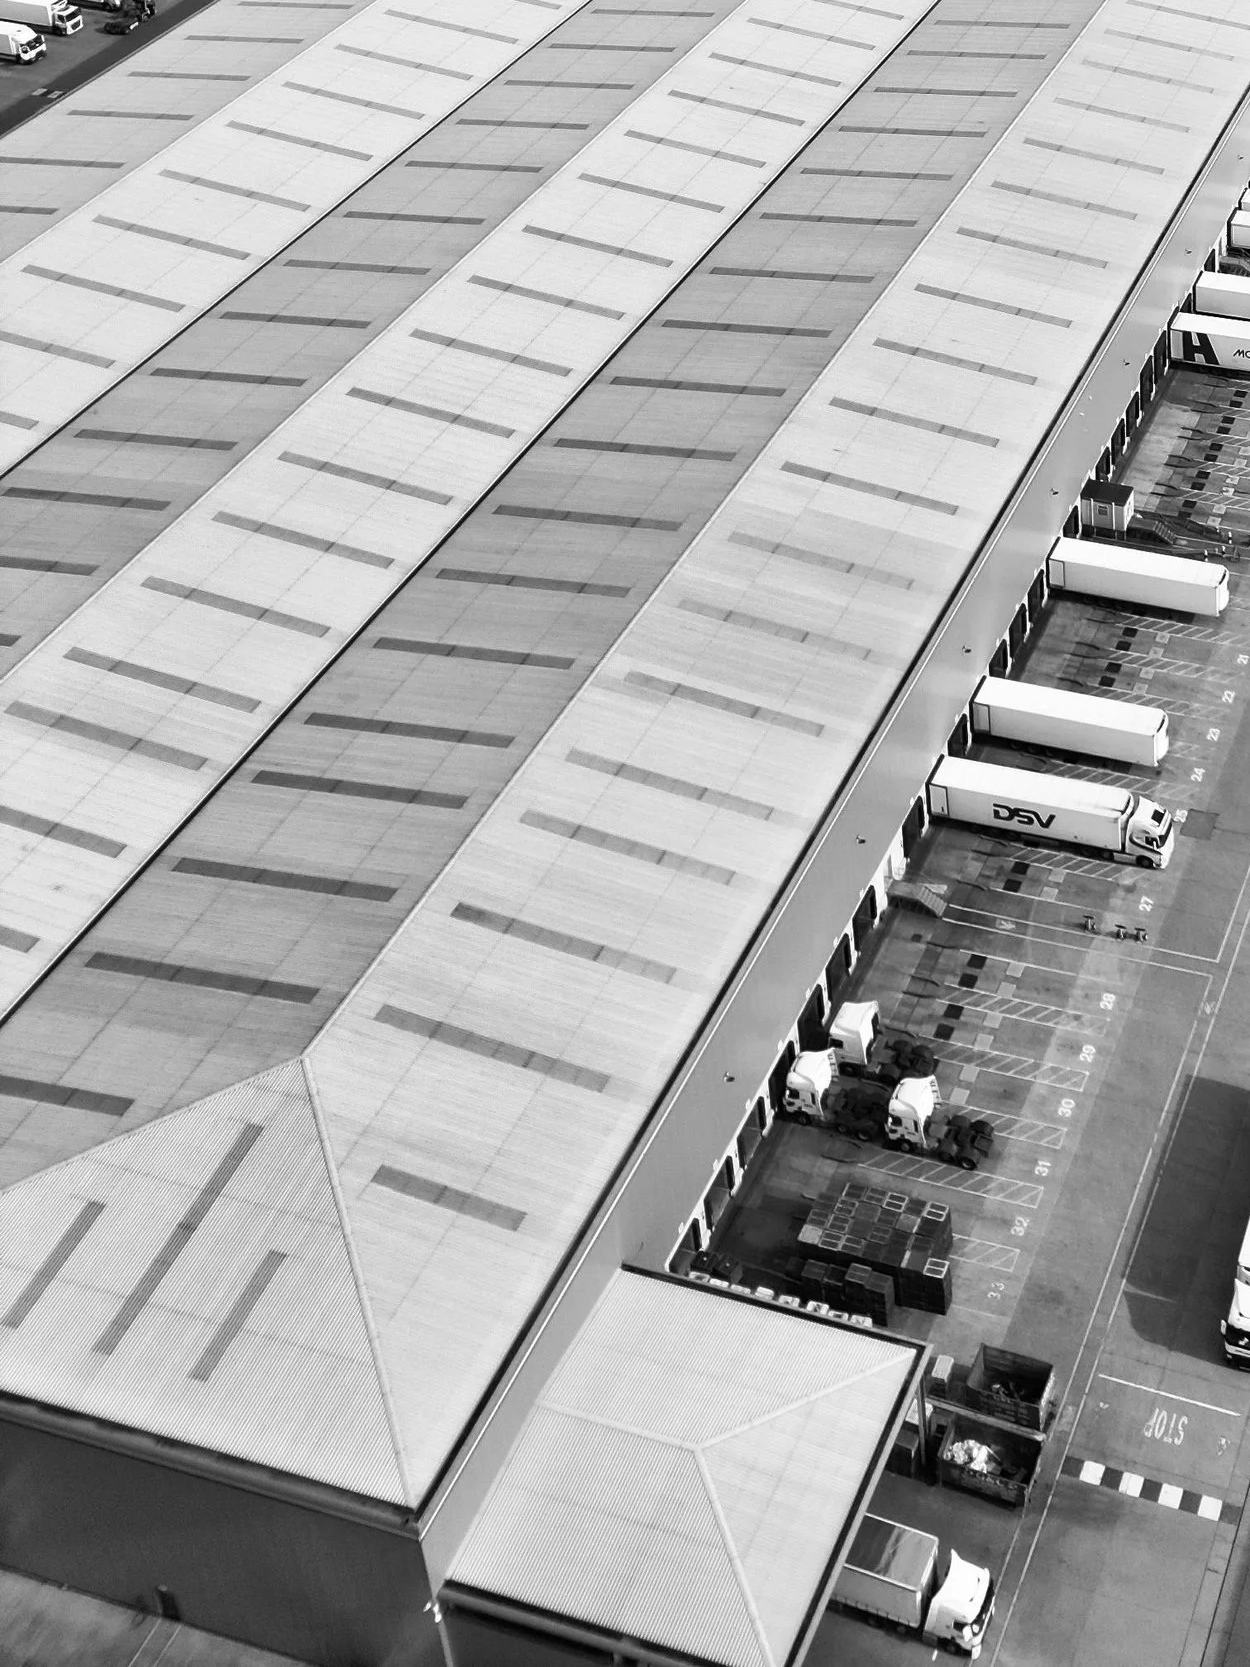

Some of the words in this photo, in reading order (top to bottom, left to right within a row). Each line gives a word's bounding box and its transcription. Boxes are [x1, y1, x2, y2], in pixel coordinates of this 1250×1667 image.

[1236, 653, 1250, 665] 21
[1222, 690, 1236, 703] 22
[1206, 728, 1221, 742] 23
[1190, 767, 1206, 782] 24
[992, 802, 1056, 829] DSV
[1173, 809, 1189, 823] 25
[1138, 895, 1155, 912] 27
[1099, 992, 1116, 1010] 28
[1079, 1043, 1096, 1063] 29
[1057, 1097, 1077, 1118] 30
[1034, 1160, 1052, 1177] 31
[1010, 1216, 1030, 1237] 32
[1143, 1407, 1189, 1446] STOP
